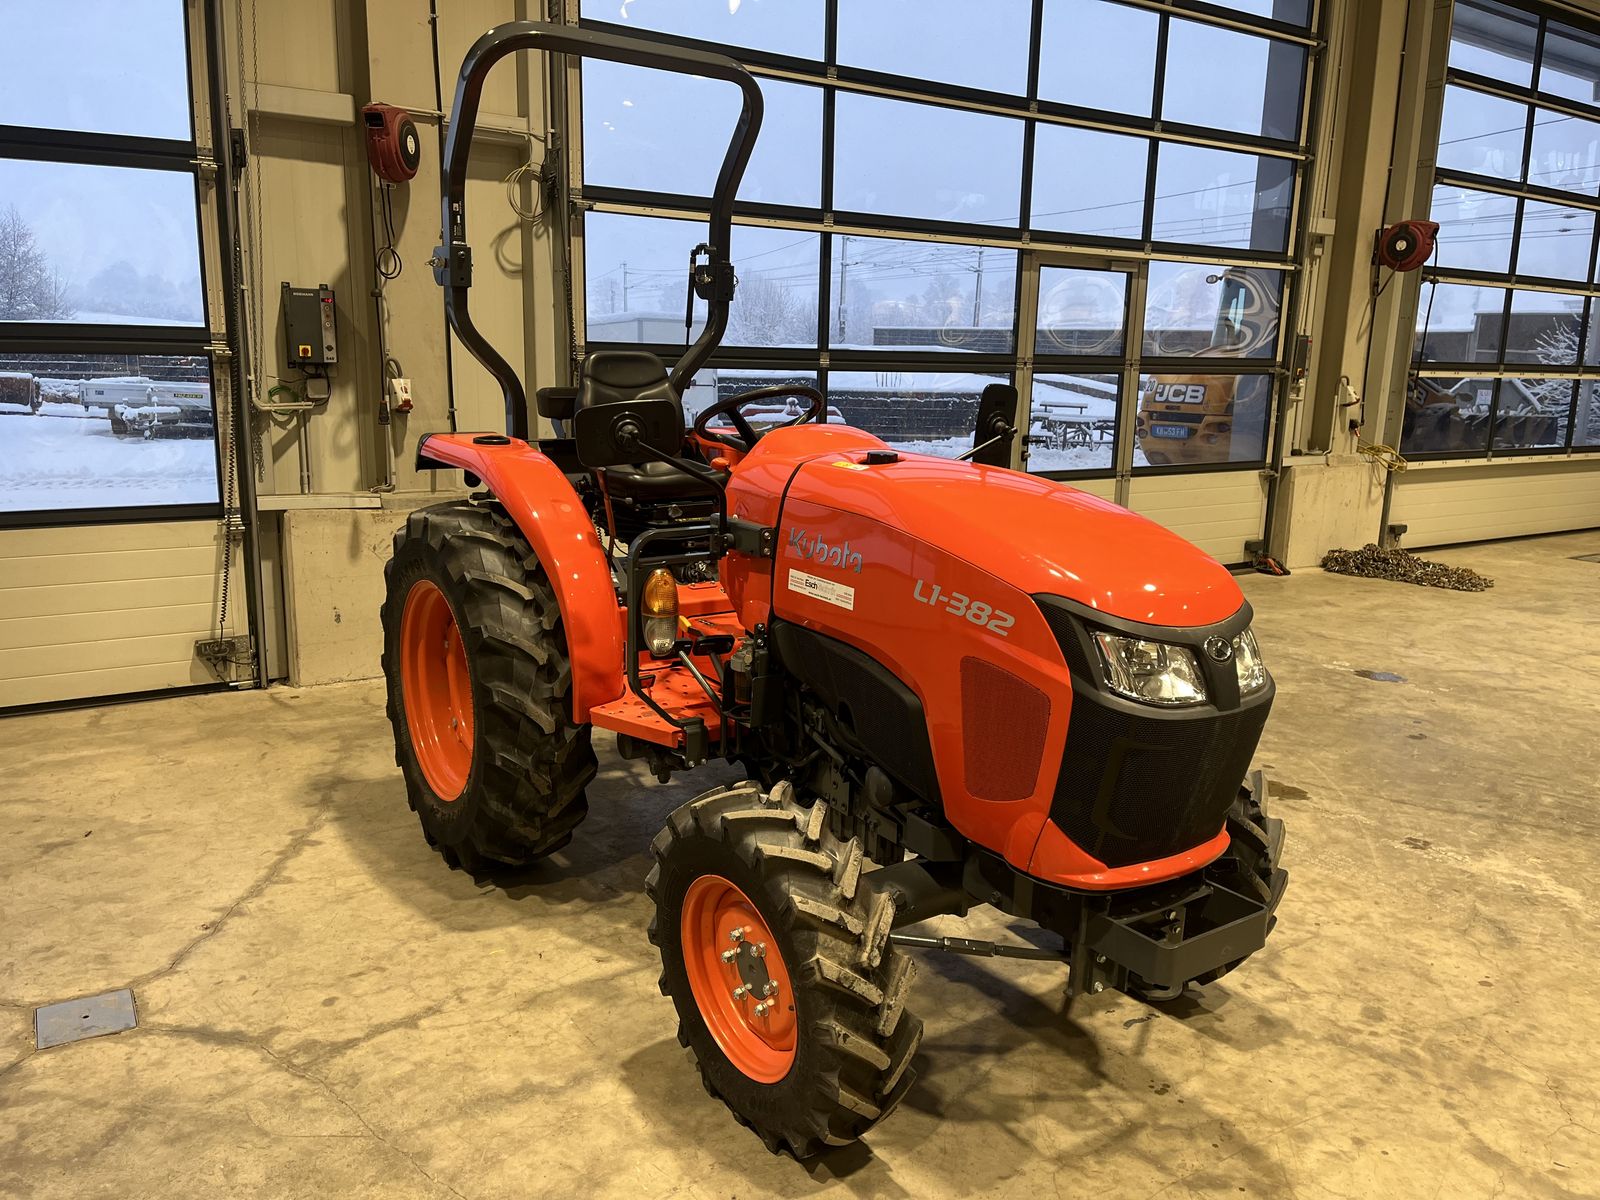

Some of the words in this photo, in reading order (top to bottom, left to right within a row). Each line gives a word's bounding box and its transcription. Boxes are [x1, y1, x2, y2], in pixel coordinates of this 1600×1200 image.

[1155, 384, 1205, 403] JCB
[789, 527, 863, 573] Kubota
[913, 579, 1016, 637] L1-382
